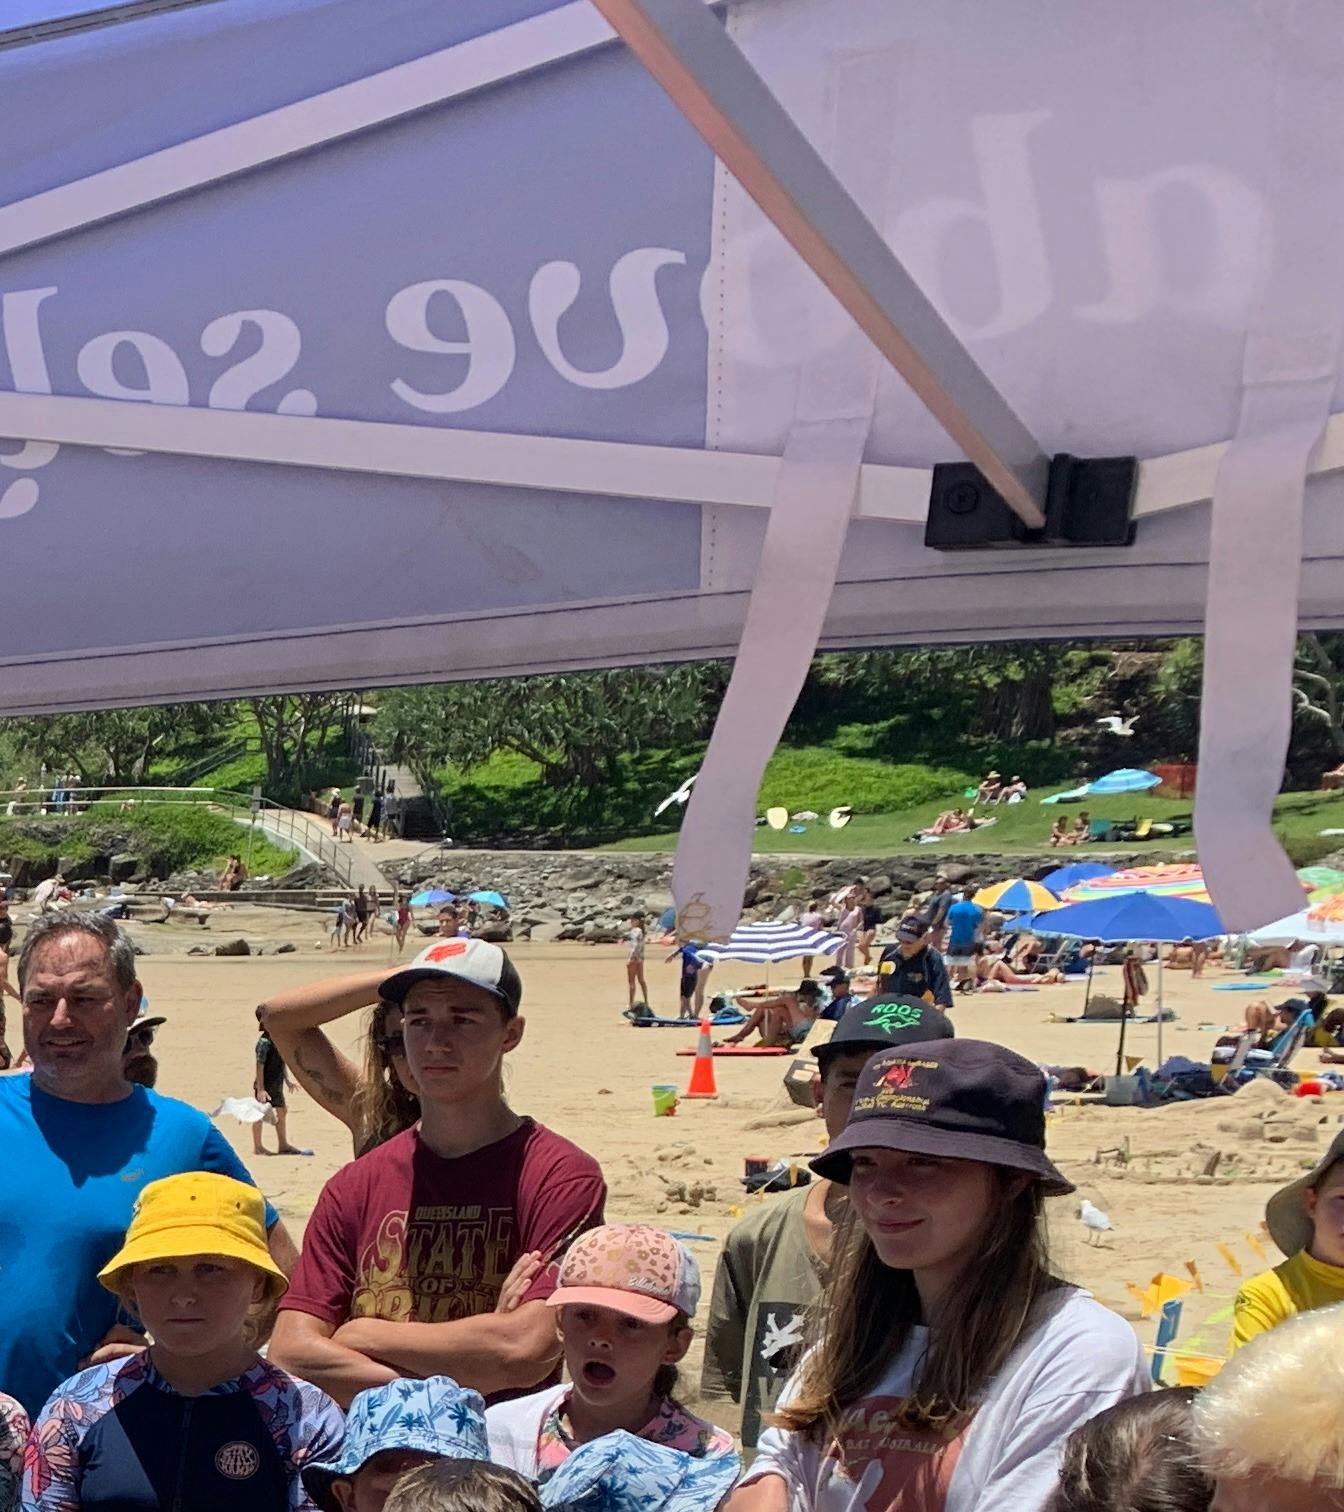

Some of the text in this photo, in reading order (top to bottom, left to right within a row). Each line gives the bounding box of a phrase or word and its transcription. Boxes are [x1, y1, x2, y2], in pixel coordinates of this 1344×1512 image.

[870, 1003, 923, 1019] ROOS
[414, 1205, 482, 1220] QUEENSLAND
[359, 1207, 514, 1286] STATE
[419, 1277, 454, 1294] OF
